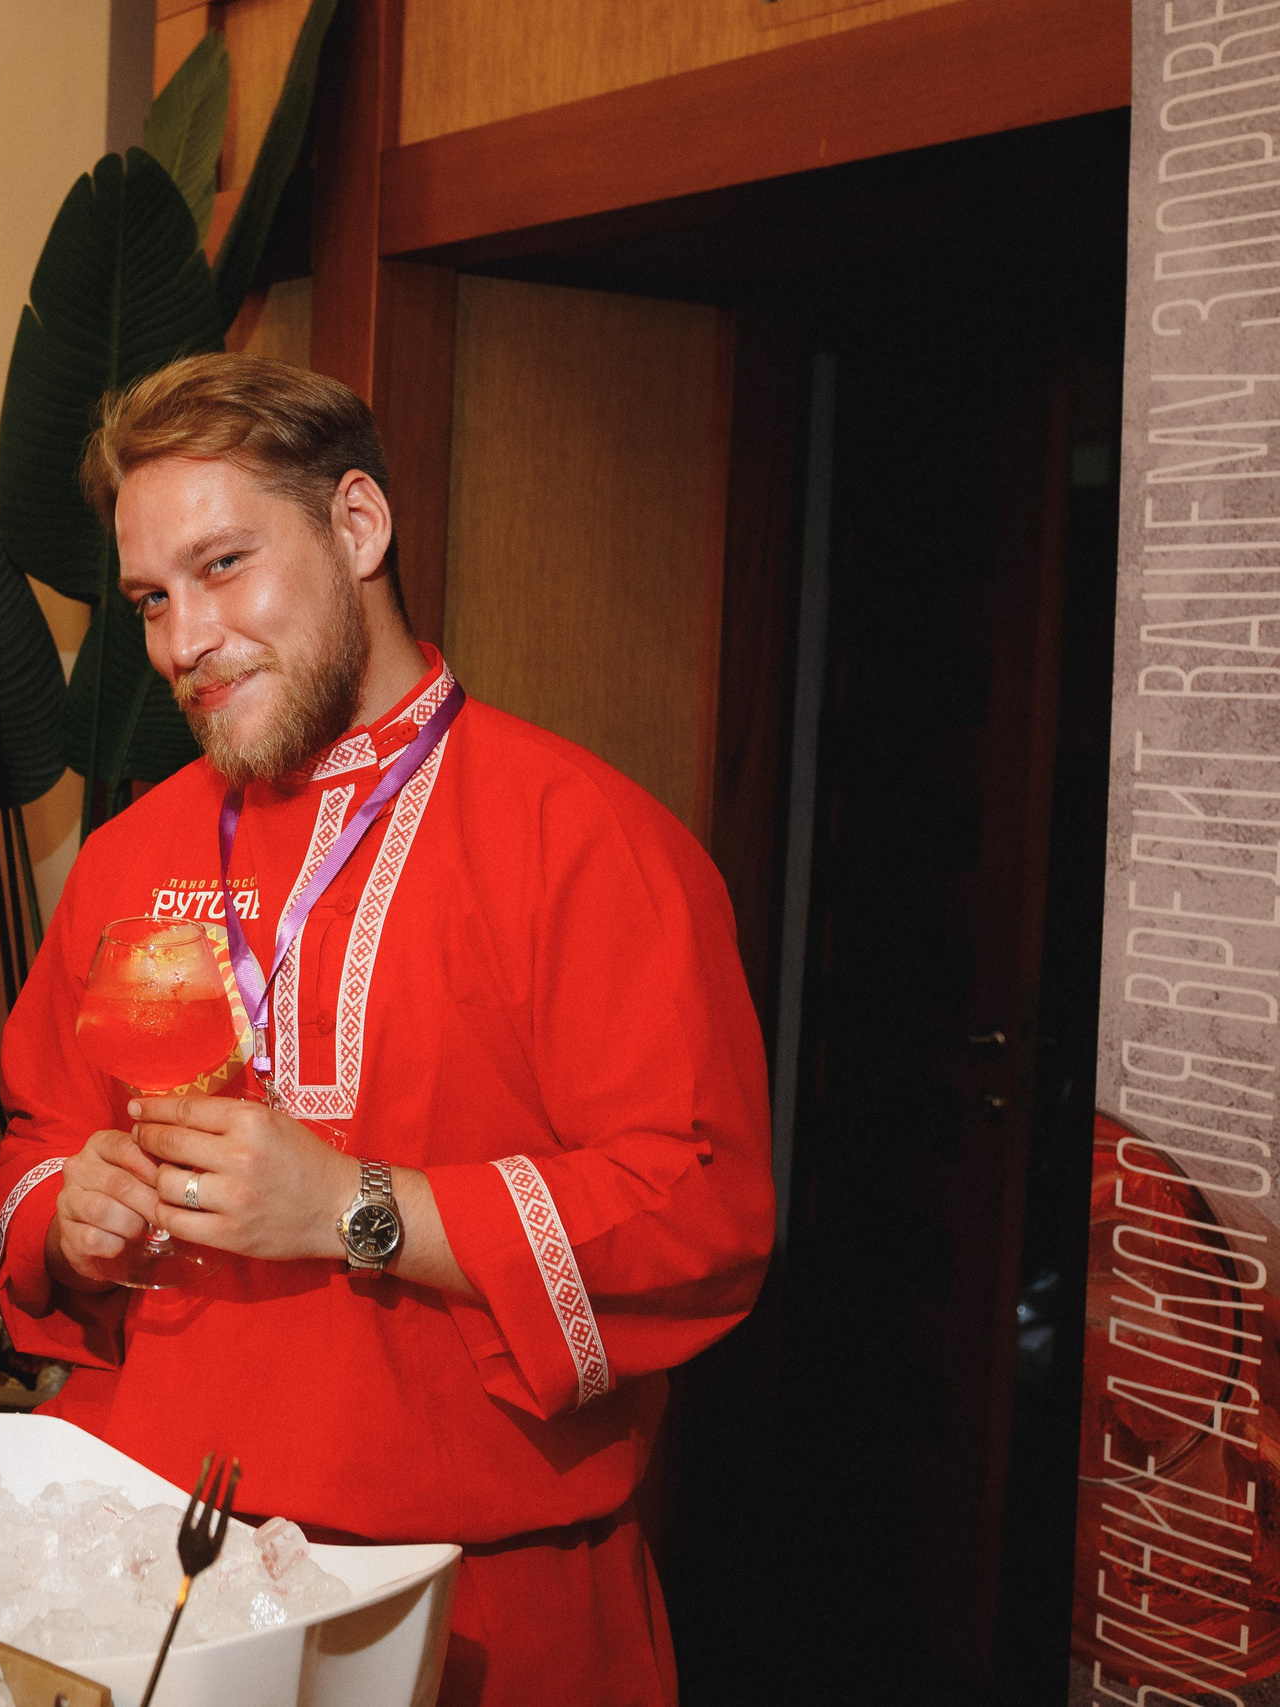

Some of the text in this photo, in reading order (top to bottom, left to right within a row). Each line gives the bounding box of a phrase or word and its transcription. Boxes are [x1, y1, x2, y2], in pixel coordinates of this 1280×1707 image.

[152, 875, 257, 897] СЛАНО В РОСС
[1124, 730, 1280, 1024] ВРЕДИТ
[1106, 1039, 1276, 1449] АЛКОГОЛЯ
[1092, 1433, 1256, 1707] БЛЕНИЕ
